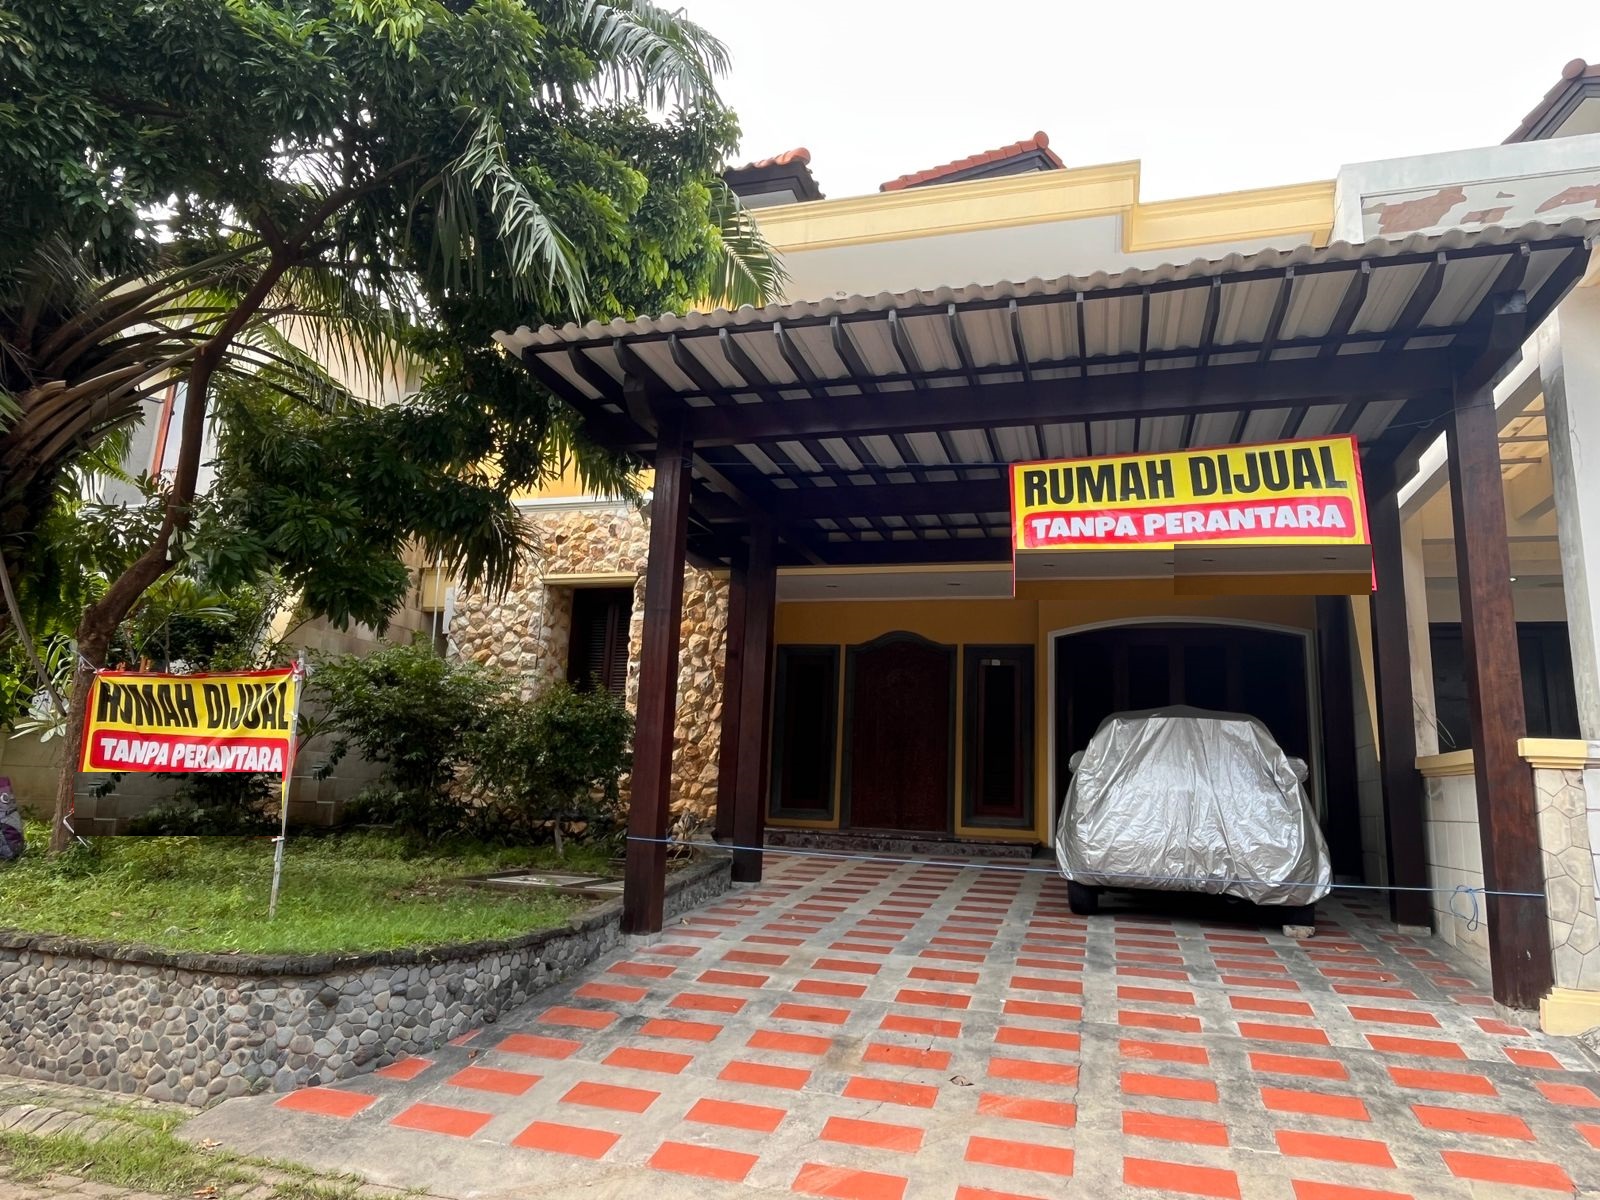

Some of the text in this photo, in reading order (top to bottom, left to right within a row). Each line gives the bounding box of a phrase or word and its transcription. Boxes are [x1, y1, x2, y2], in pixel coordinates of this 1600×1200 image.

[1023, 446, 1347, 507] RUMAH DIJUAL
[1031, 504, 1346, 539] TANPA PERANTARA
[96, 681, 288, 730] RUMAH DIJUAL
[100, 737, 283, 772] TANPA PERANTARA
